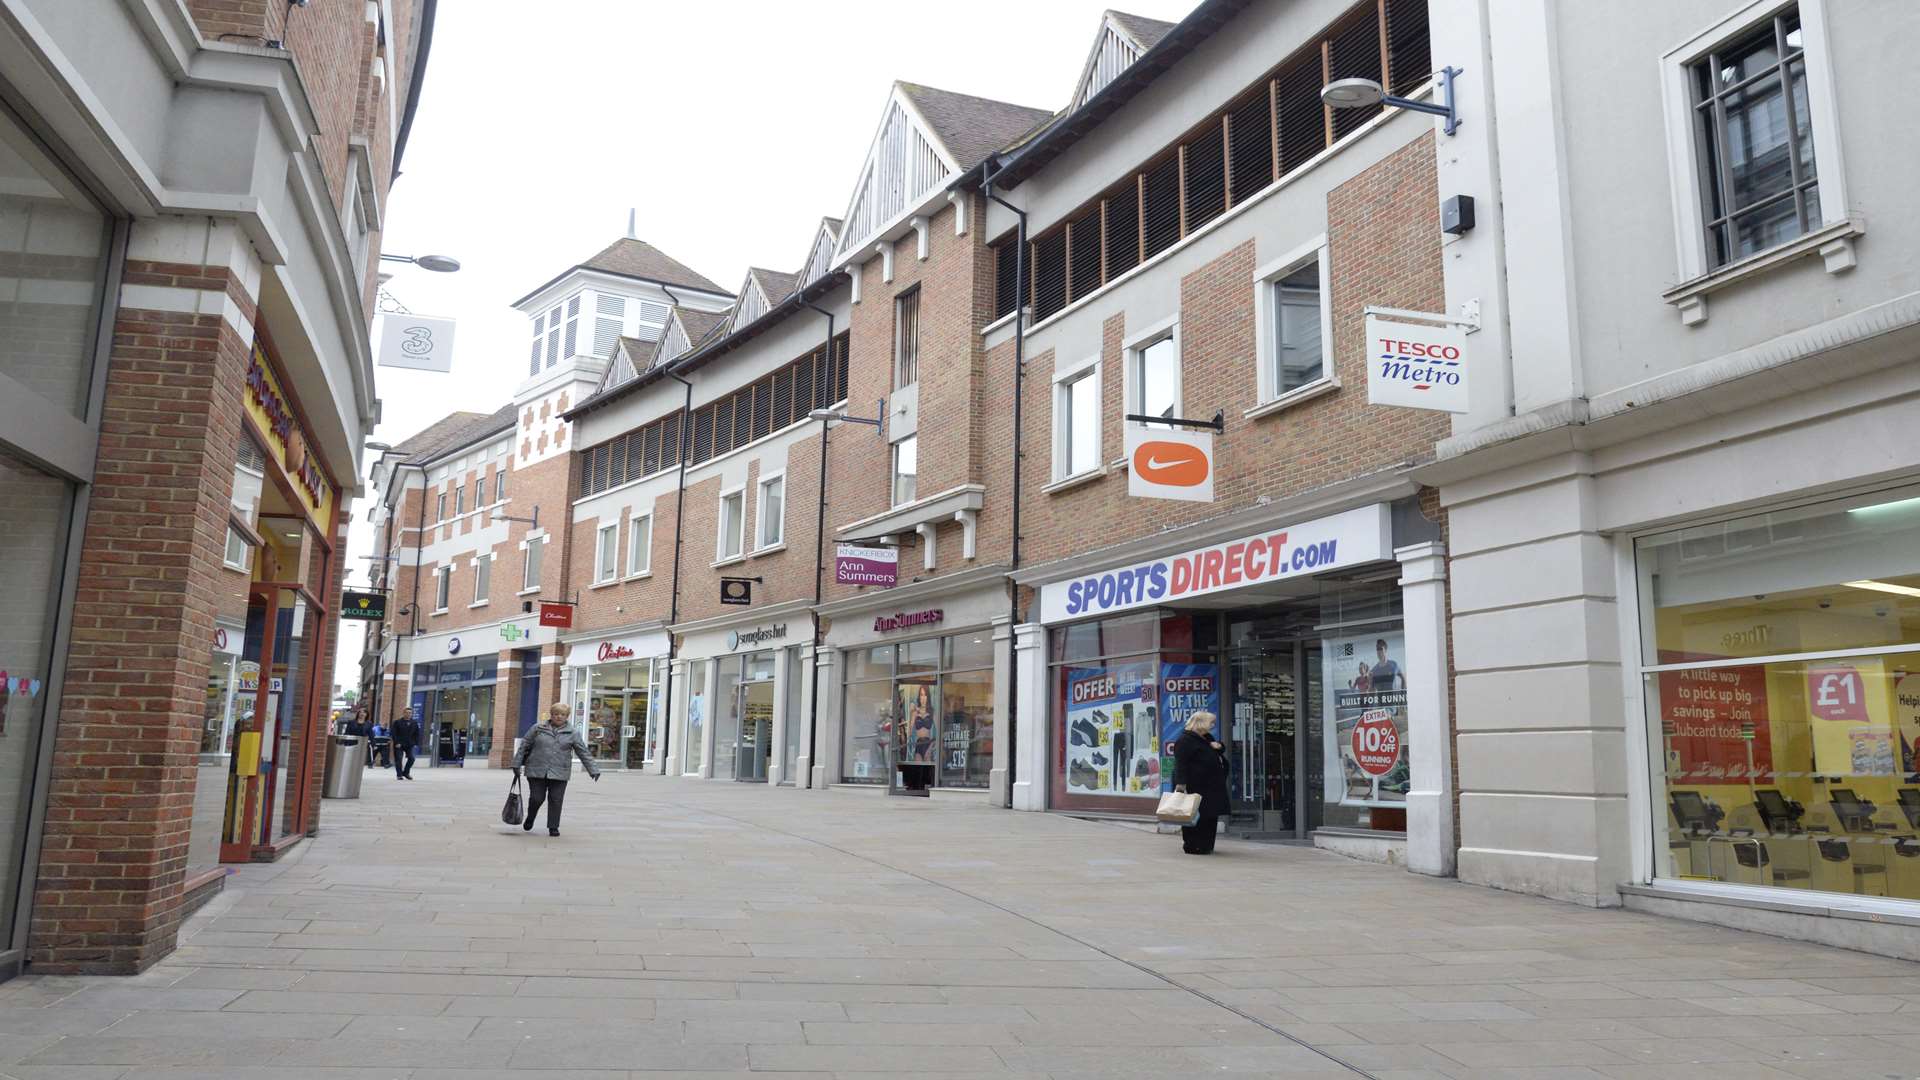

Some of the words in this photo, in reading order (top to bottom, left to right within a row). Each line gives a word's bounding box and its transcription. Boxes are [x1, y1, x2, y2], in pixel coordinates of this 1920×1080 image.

[1379, 338, 1460, 360] TESCO
[1381, 361, 1460, 386] Metro
[839, 560, 864, 571] Ann
[839, 570, 895, 583] Summers
[344, 607, 383, 617] ROLEX
[1680, 668, 1689, 679] A
[1691, 668, 1717, 681] little
[1720, 670, 1741, 685] way
[1074, 677, 1115, 702] OFFER
[1166, 679, 1210, 692] OFFER
[1817, 673, 1857, 706] £1
[1169, 694, 1184, 709] OF
[1186, 693, 1209, 707] THE
[1341, 695, 1361, 706] BUILT
[1363, 695, 1379, 705] FOR
[1381, 693, 1408, 704] RUNN
[1678, 687, 1690, 698] to
[1693, 686, 1717, 702] pick
[1720, 690, 1733, 704] up
[1736, 688, 1752, 704] big
[1365, 710, 1386, 721] EXTRA
[1672, 705, 1716, 721] savings
[1730, 706, 1751, 720] Join
[1356, 727, 1396, 752] 10%
[1380, 744, 1395, 753] OFF
